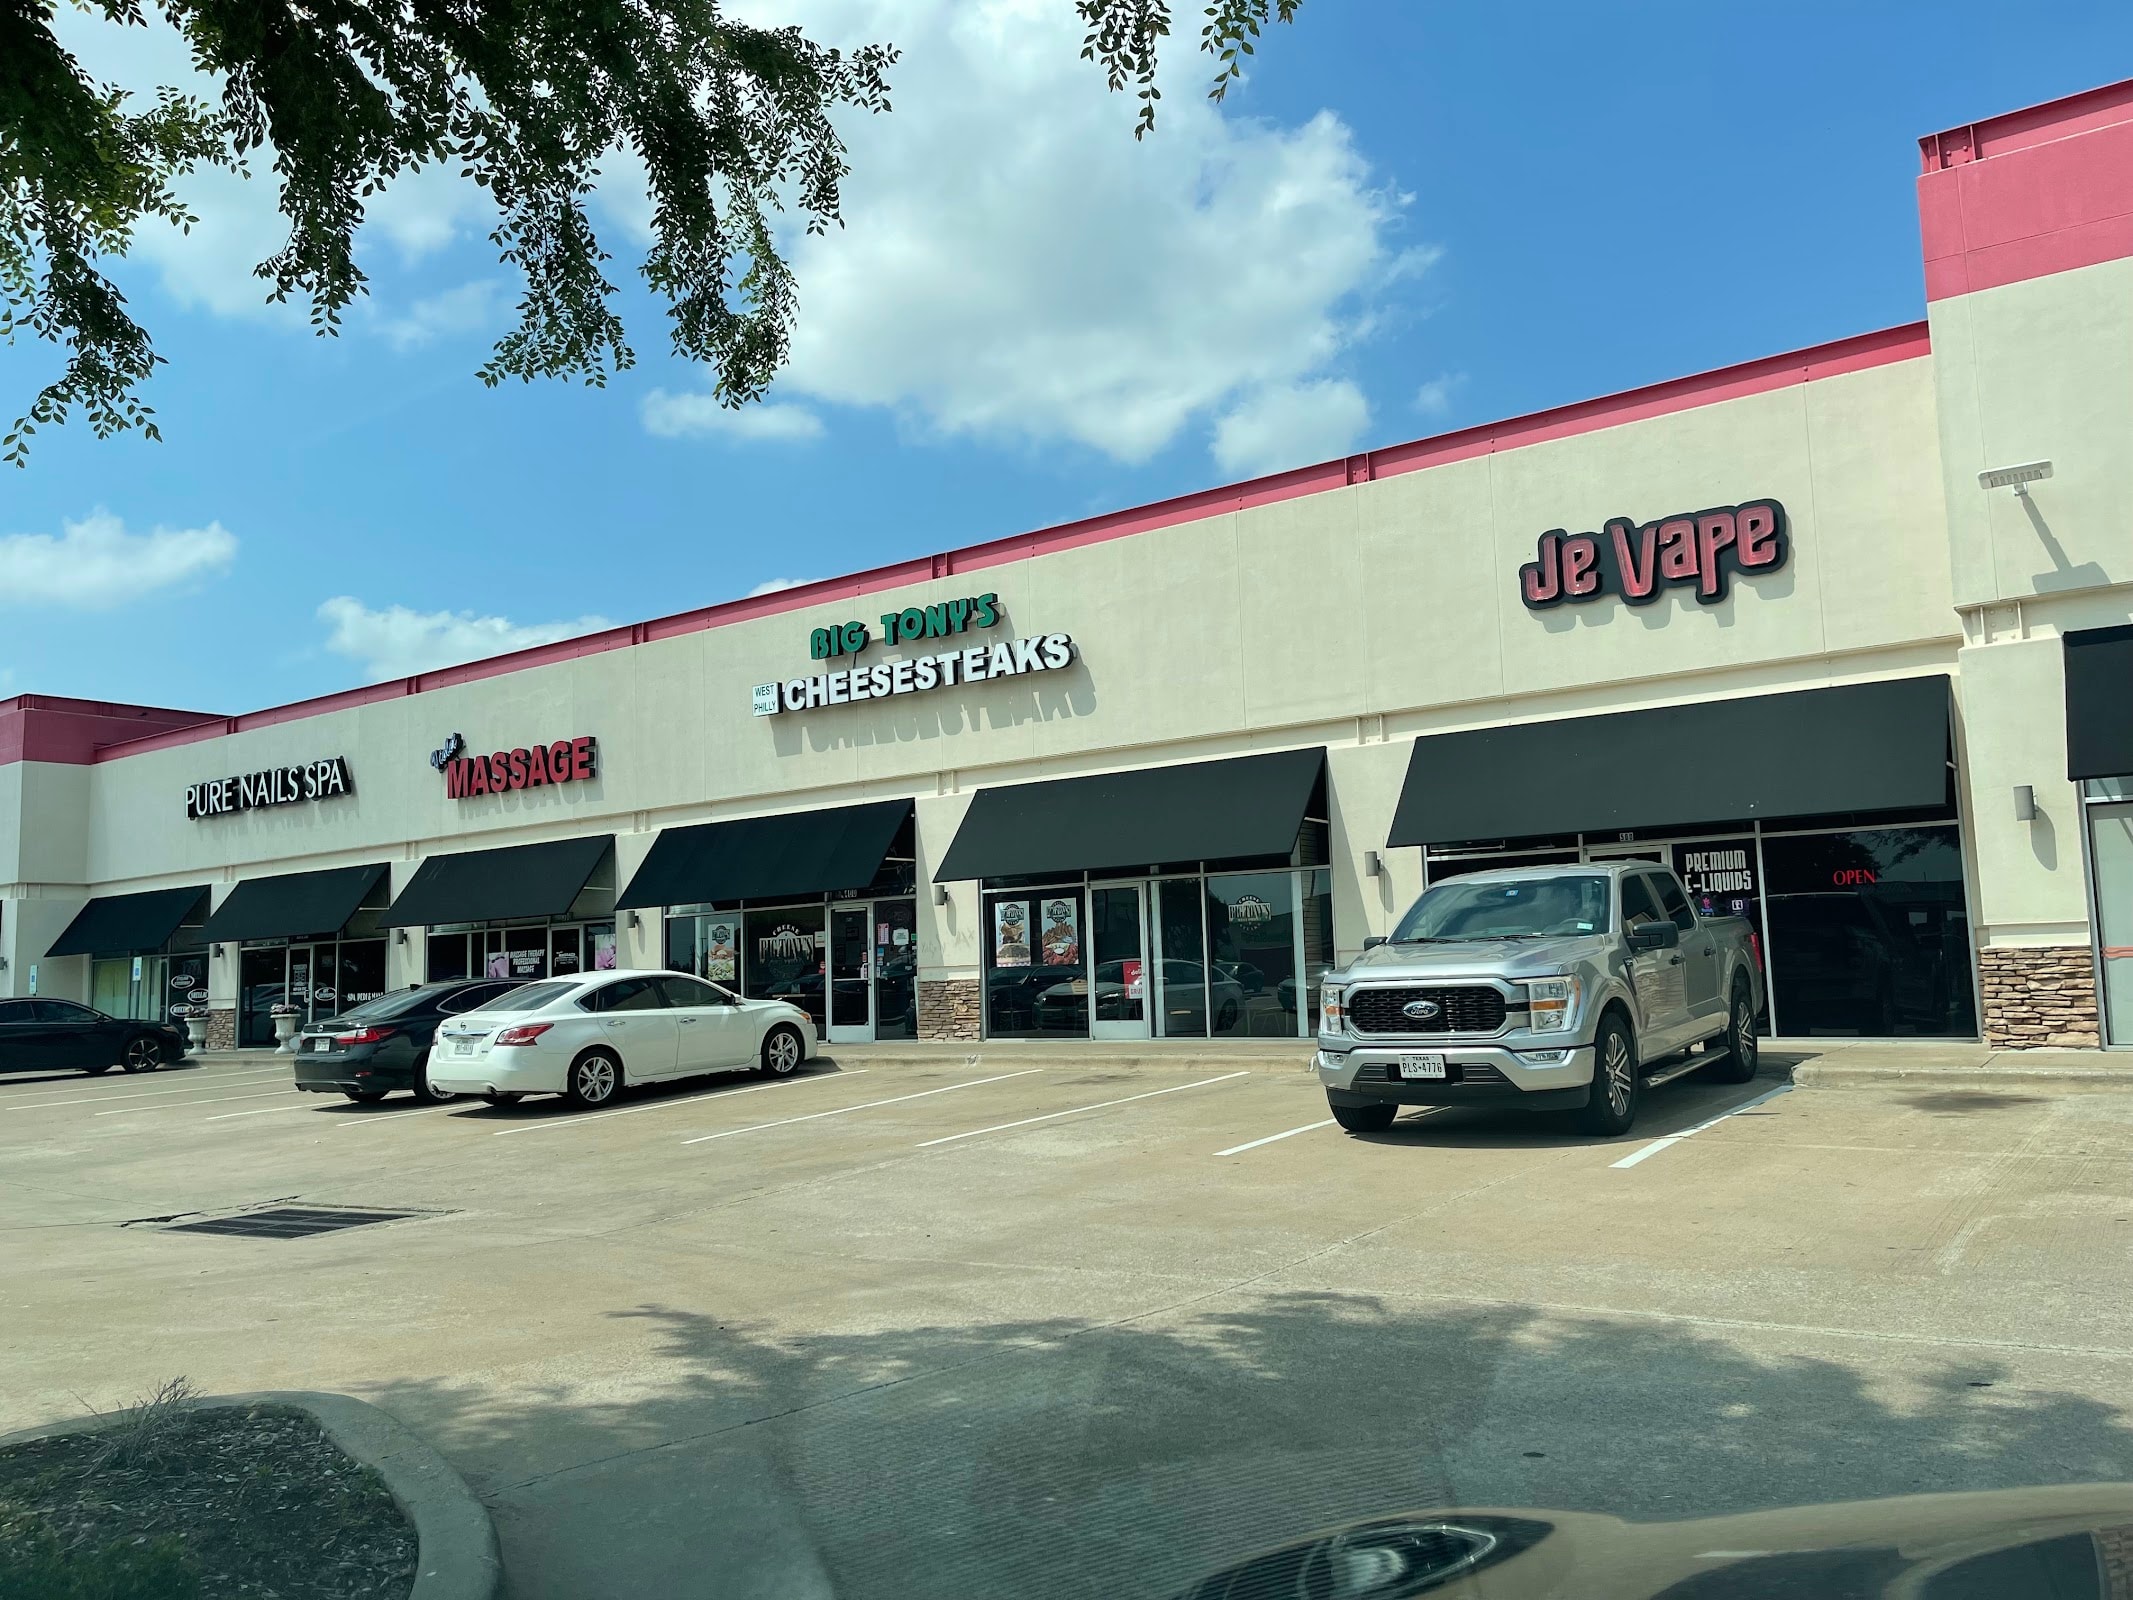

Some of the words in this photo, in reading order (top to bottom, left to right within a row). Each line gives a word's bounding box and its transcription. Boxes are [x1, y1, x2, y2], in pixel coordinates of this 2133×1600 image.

[1525, 536, 1598, 602] Je
[1611, 505, 1778, 598] Vape
[810, 621, 869, 660] BIG
[880, 593, 999, 646] TONY'S
[754, 684, 775, 698] WEST
[784, 633, 1074, 712] CHEESESTEAKS
[753, 699, 777, 714] PHILLY
[185, 777, 234, 819] PURE
[239, 766, 300, 808] NAILS
[304, 757, 349, 799] SPA
[447, 736, 596, 799] MASSAGE
[1684, 870, 1752, 893] E-LIQUIDS
[1685, 850, 1747, 872] PREMIUM
[1833, 869, 1876, 886] OPEN
